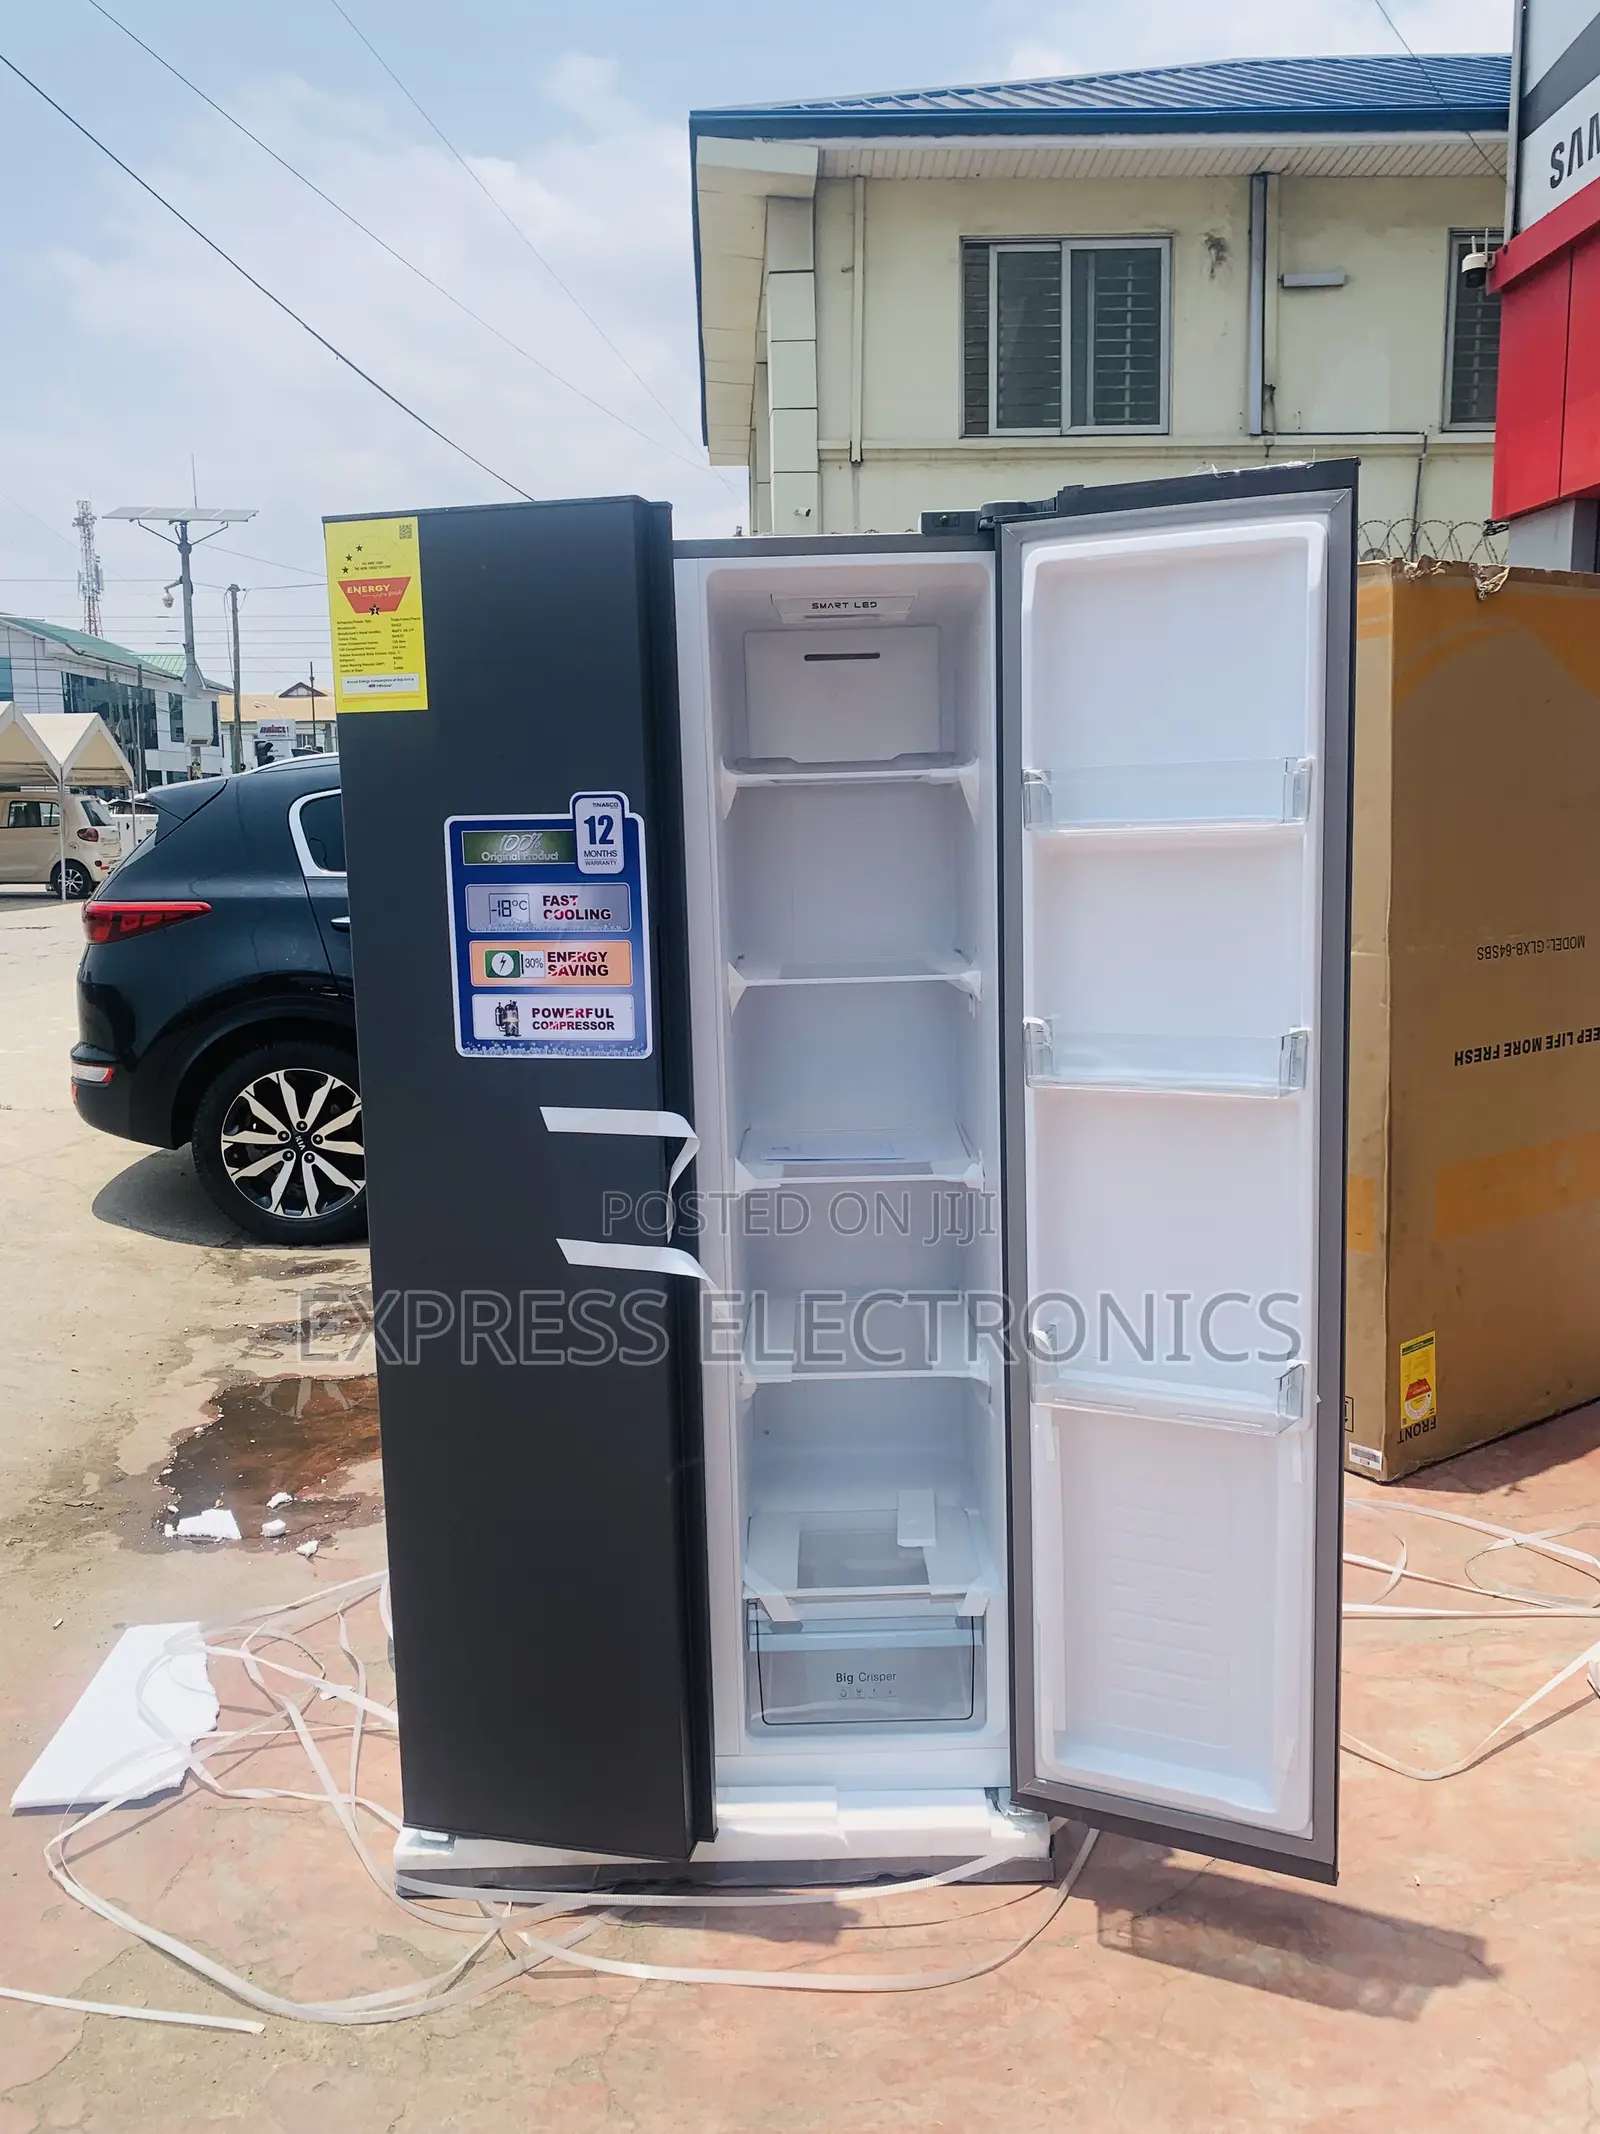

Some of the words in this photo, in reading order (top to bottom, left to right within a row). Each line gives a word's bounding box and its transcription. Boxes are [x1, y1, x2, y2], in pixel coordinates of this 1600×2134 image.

[347, 584, 390, 595] ENERGY
[584, 815, 614, 844] 12
[500, 832, 542, 852] 100%
[481, 850, 520, 863] Original
[521, 850, 559, 862] Product
[542, 895, 578, 906] FAST
[544, 909, 612, 920] COOLING
[1476, 940, 1544, 960] GLXB-64SBS
[1547, 935, 1586, 952] MODEL:
[524, 958, 544, 968] 30%
[548, 952, 608, 962] ENERGY
[548, 964, 609, 976] SAVING
[532, 1008, 614, 1018] POWERFUL
[532, 1021, 615, 1030] COMPRESSOR
[1546, 1032, 1574, 1050] LIFE
[1577, 1026, 1600, 1044] EEP
[1504, 1037, 1542, 1057] MORE
[1454, 1044, 1500, 1066] FRESH
[295, 1136, 306, 1150] KIA
[1398, 1415, 1436, 1444] FRONT
[836, 1672, 854, 1684] Big
[858, 1672, 897, 1682] Crisper
